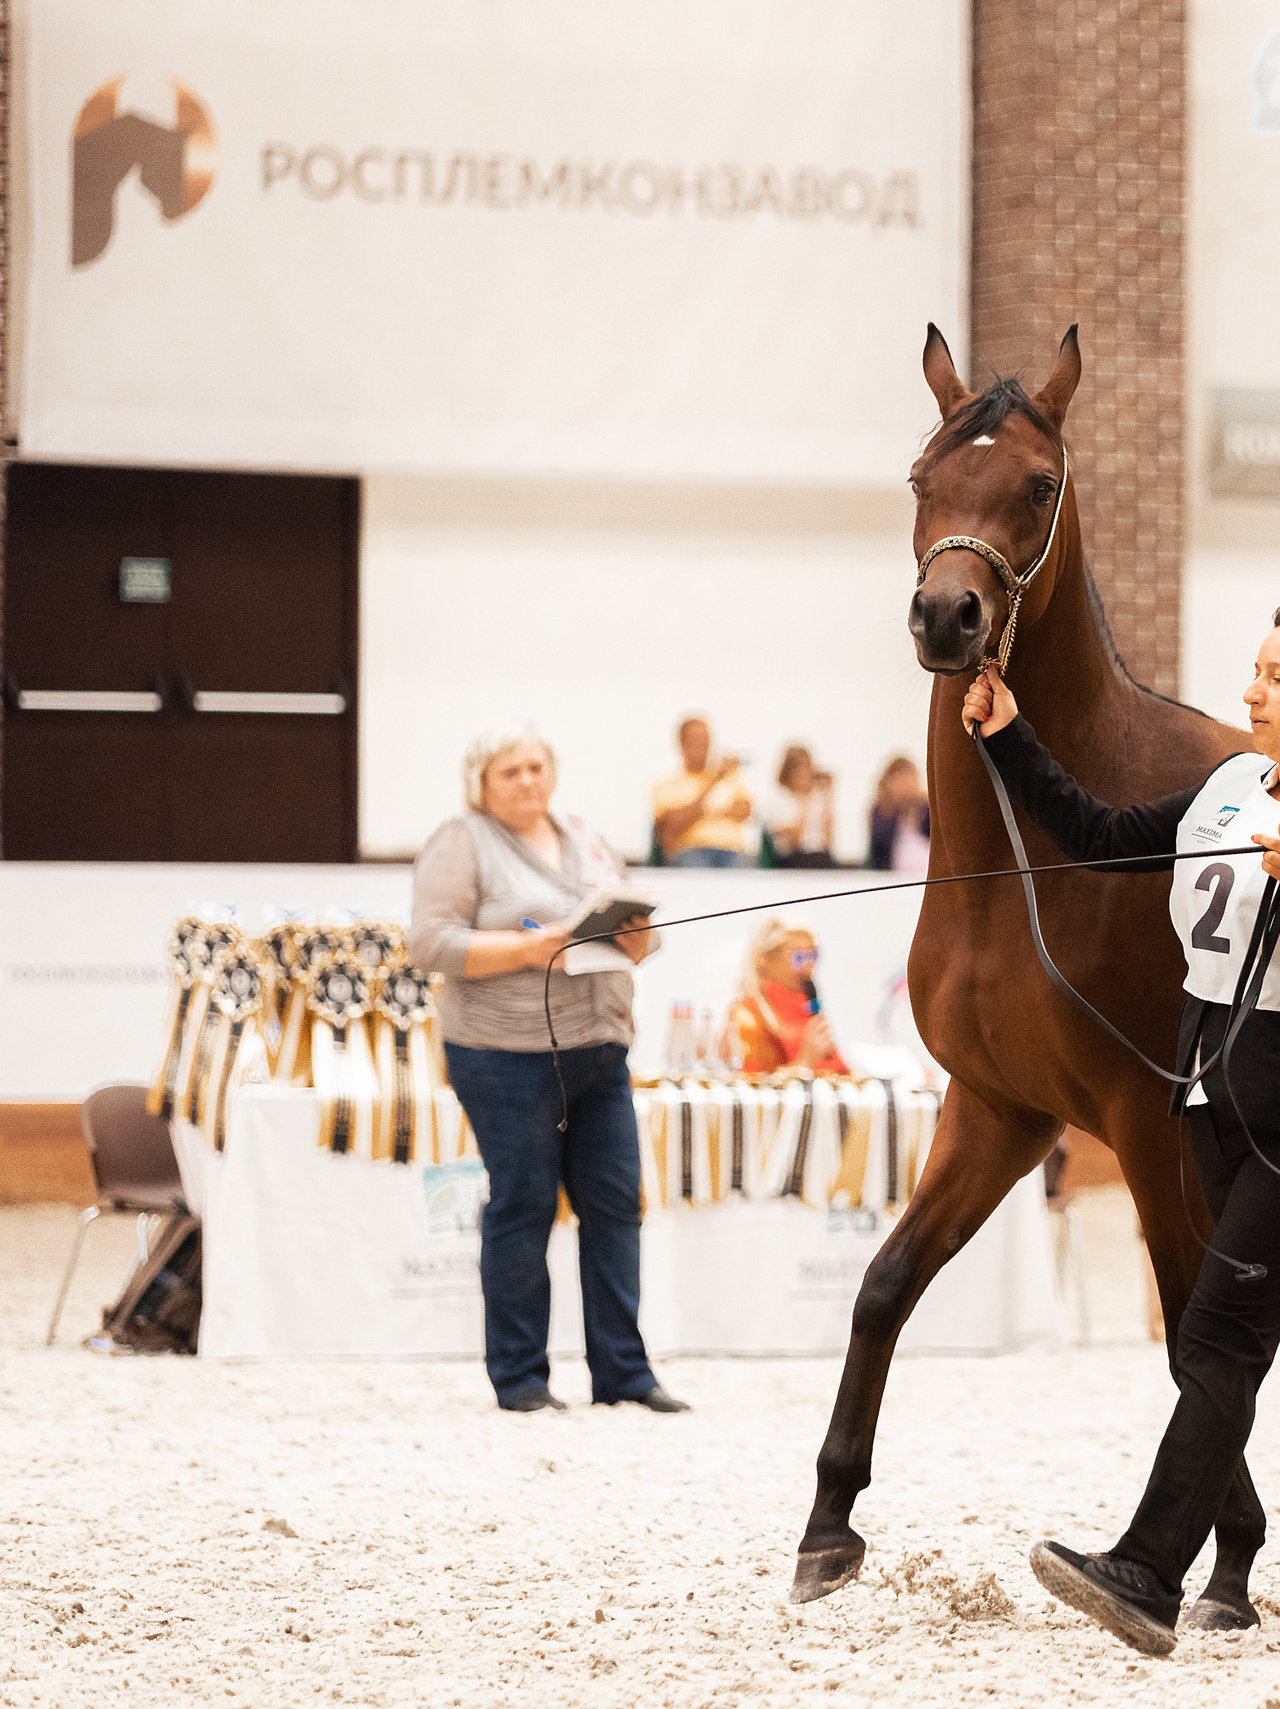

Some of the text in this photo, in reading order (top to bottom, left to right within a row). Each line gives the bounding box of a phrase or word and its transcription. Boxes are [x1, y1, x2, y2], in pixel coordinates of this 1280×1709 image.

[260, 140, 922, 231] РОСПЛЕМКОНЗАВОД
[1196, 825, 1223, 840] MAXIMA
[1191, 862, 1236, 955] 2
